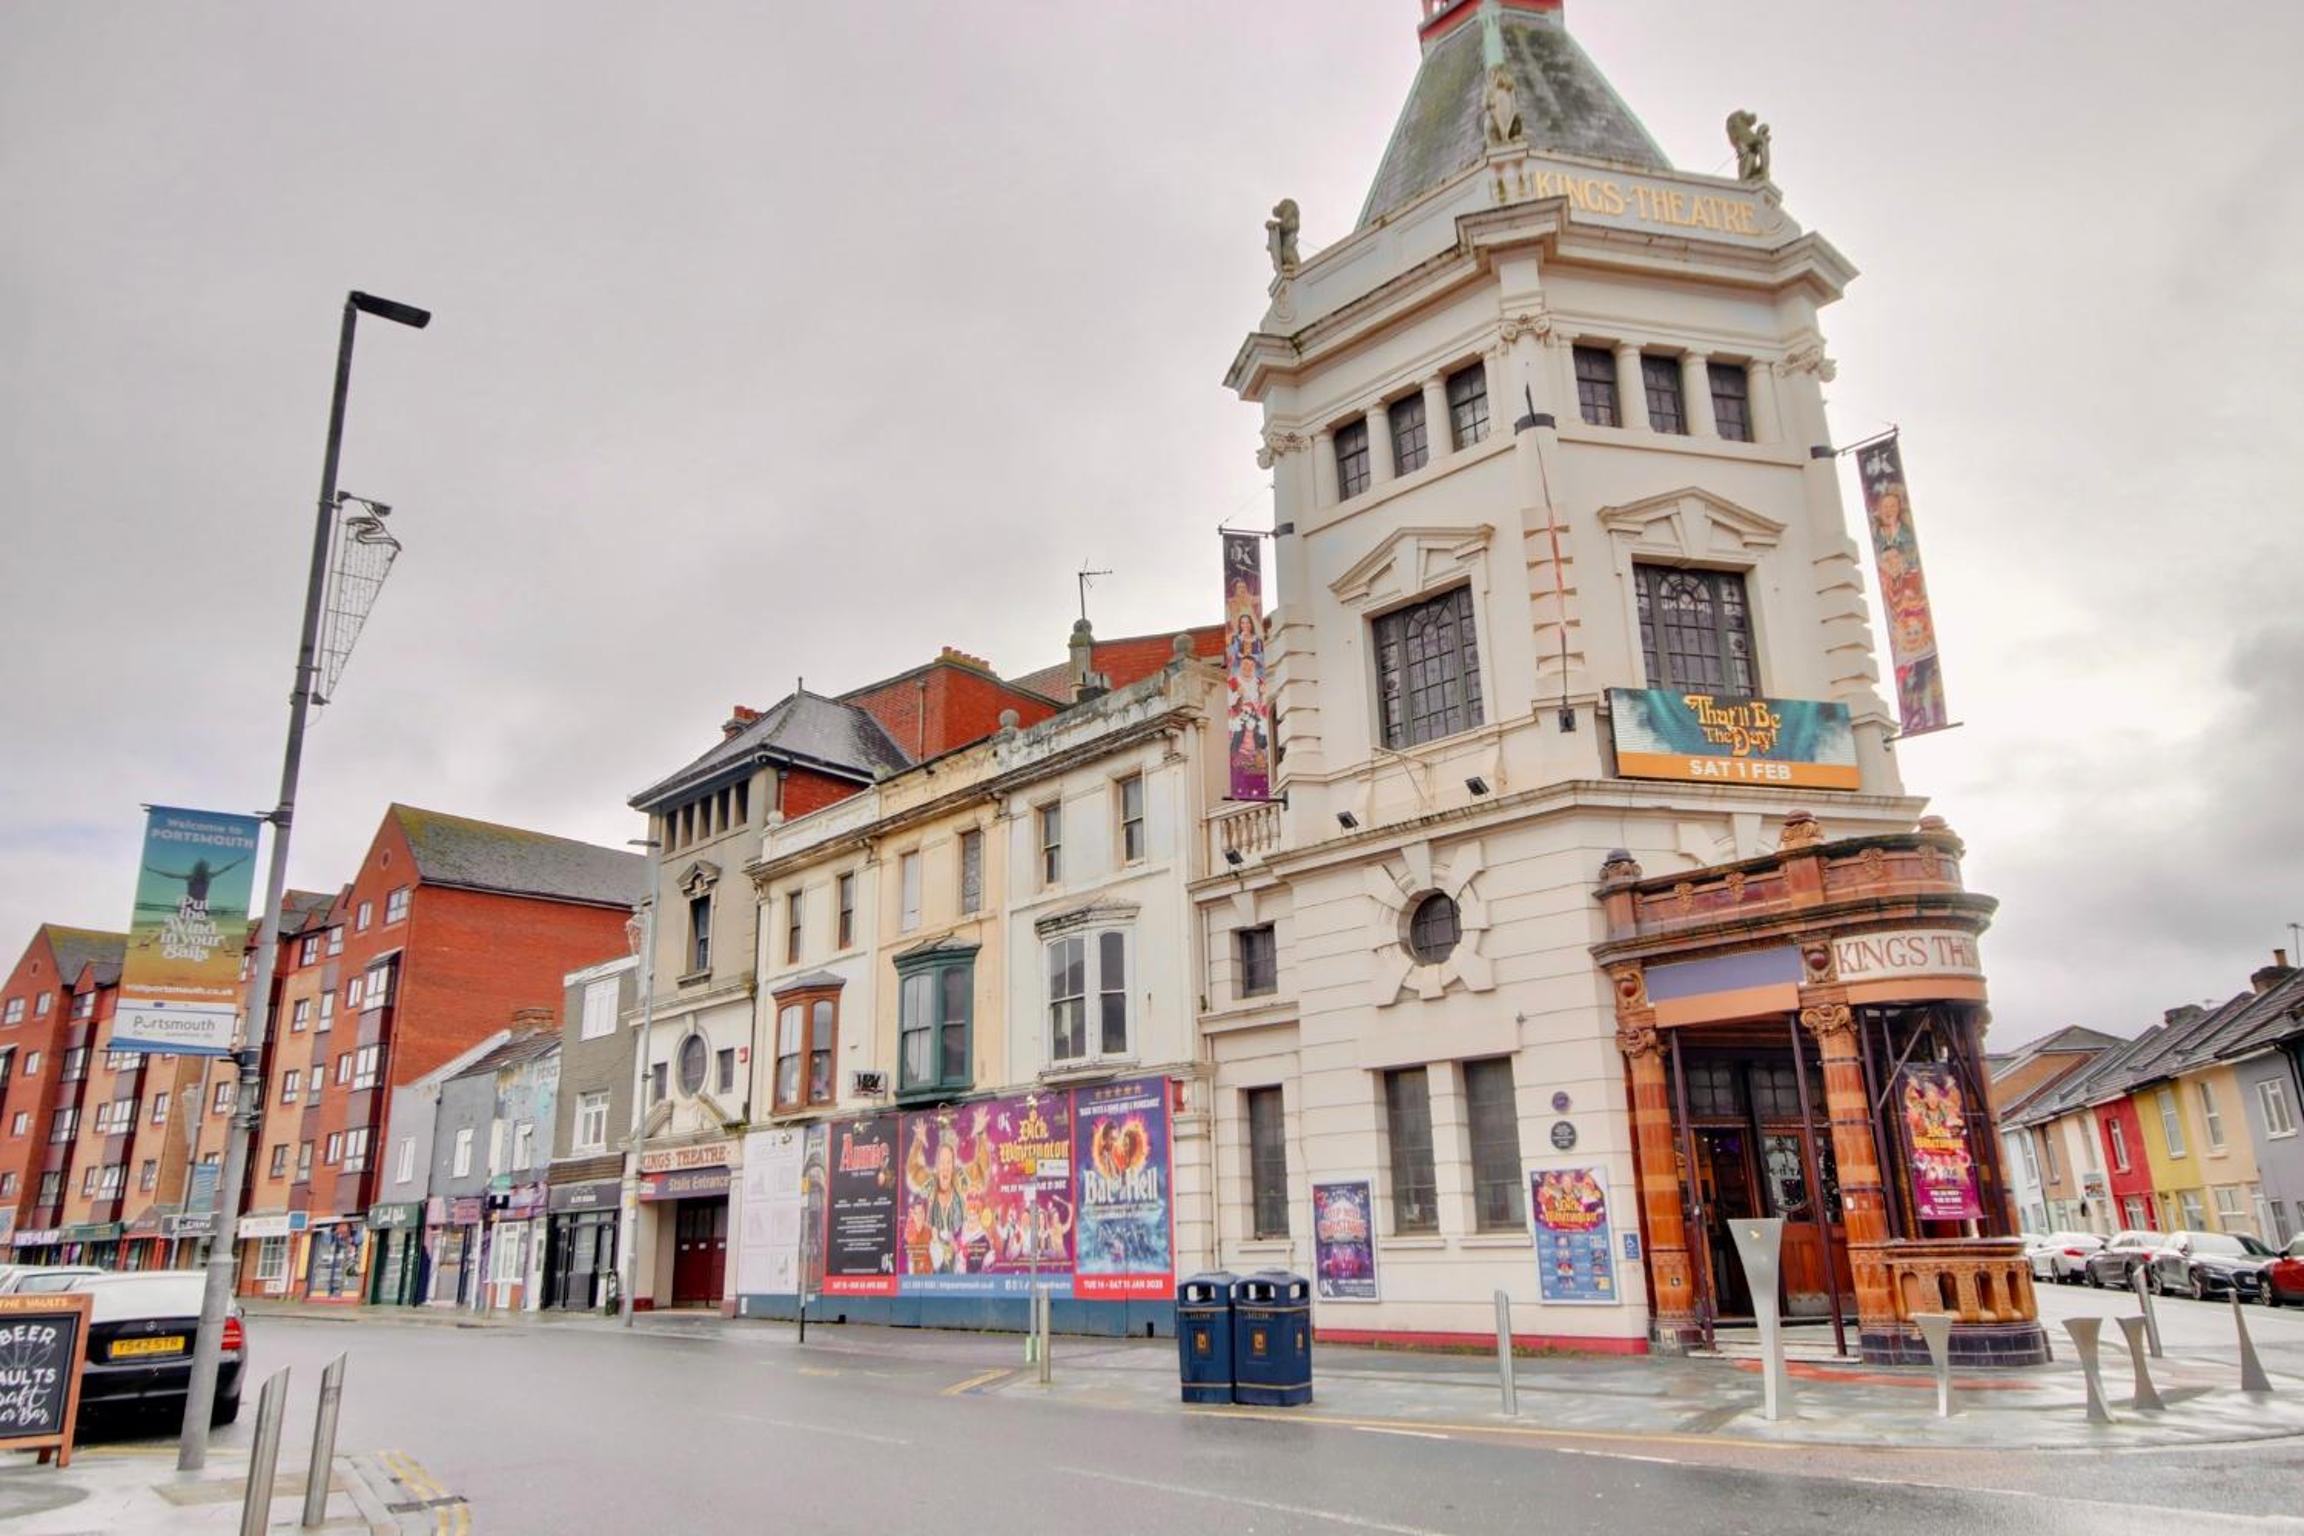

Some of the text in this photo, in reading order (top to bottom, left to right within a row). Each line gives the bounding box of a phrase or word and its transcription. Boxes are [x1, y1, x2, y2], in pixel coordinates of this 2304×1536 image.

[1535, 171, 1761, 236] KINGS THEATRE
[1751, 702, 1782, 729] Be
[1703, 726, 1732, 744] The
[1690, 759, 1793, 780] SAT 1 FEB
[166, 818, 225, 833] Welcome
[150, 829, 255, 848] PORTSMOUTH
[180, 896, 210, 910] Put
[179, 907, 208, 921] the
[160, 930, 178, 944] in
[676, 1146, 727, 1166] THEATRE
[838, 1132, 890, 1172] Annie
[692, 1175, 729, 1190] Entrance
[1083, 1169, 1116, 1205] Bat
[1126, 1167, 1159, 1202] Hell
[0, 1324, 56, 1346] BEER
[0, 1367, 56, 1386] AULTS
